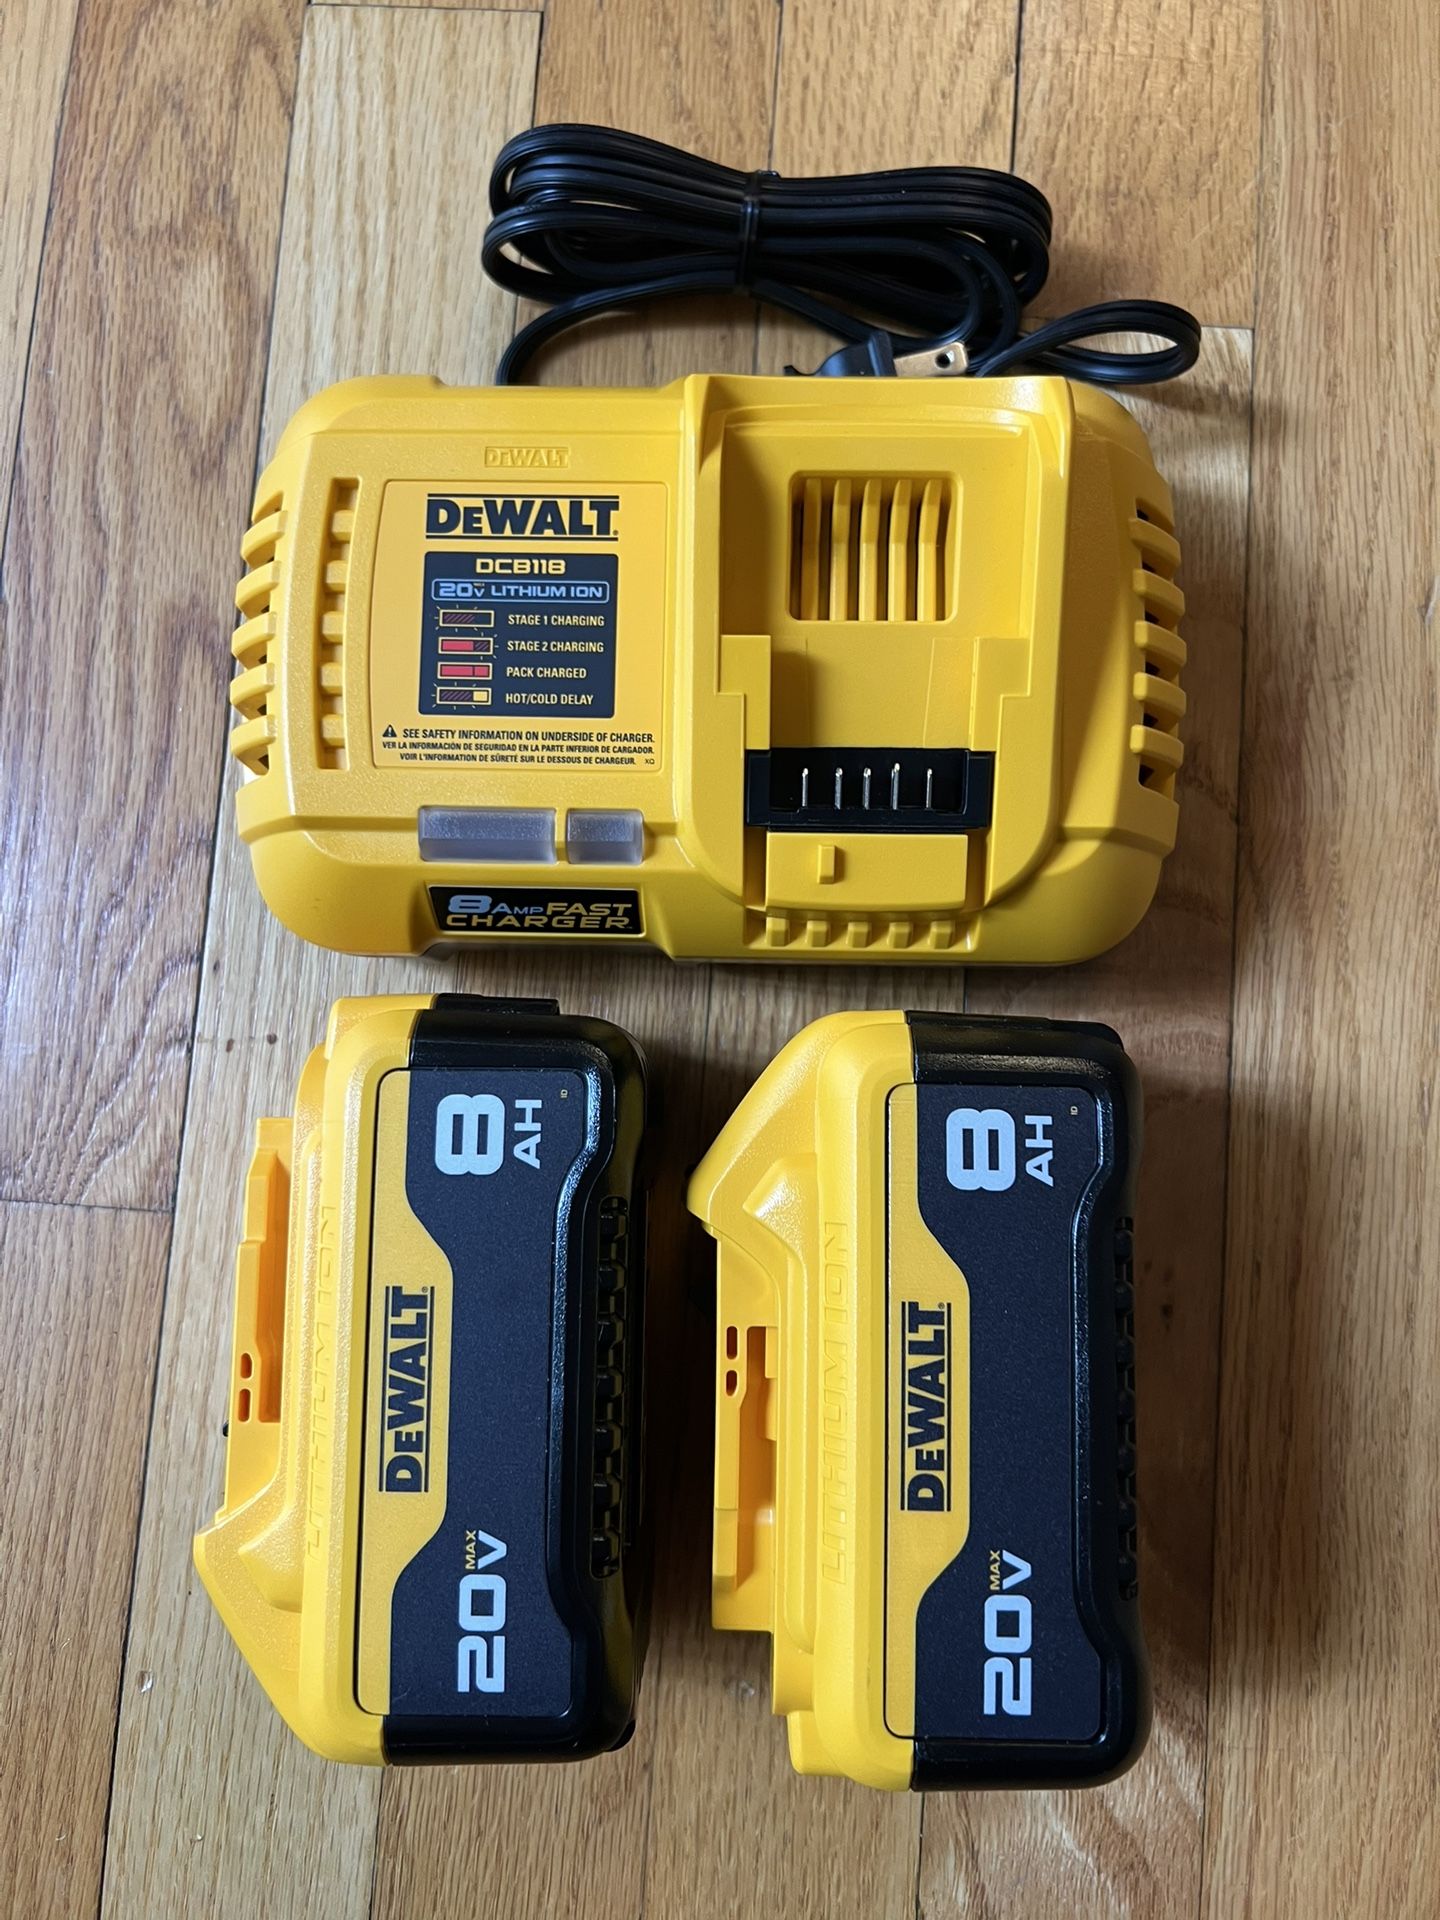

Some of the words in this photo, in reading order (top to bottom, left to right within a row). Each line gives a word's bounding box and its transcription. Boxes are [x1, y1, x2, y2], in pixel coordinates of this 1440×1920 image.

[486, 448, 569, 466] DEWALT
[426, 499, 619, 535] DEWALT
[475, 558, 566, 575] DCB118
[491, 585, 565, 598] LITHIUM
[570, 586, 603, 598] ION
[508, 615, 541, 626] STAGE
[543, 615, 548, 626] 1
[551, 615, 605, 627] CHARGING
[507, 640, 540, 652] STAGE
[542, 641, 548, 652] 2
[551, 641, 604, 653] CHARGING
[506, 667, 534, 678] PACK
[537, 667, 587, 679] CHARGED
[505, 693, 558, 705] HOT/COLD
[561, 694, 594, 705] DELAY
[382, 741, 396, 749] VER
[475, 743, 517, 752] SEGURIDAD
[519, 744, 528, 752] EN
[530, 744, 540, 752] LA
[566, 745, 599, 753] INFERIOR
[403, 728, 420, 739] SEE
[422, 729, 456, 740] SAFETY
[458, 730, 523, 740] INFORMATION
[525, 731, 539, 741] ON
[541, 731, 594, 742] UNDERSIDE
[596, 732, 608, 742] OF
[610, 733, 655, 743] CHARGER.
[400, 752, 417, 760] VOIR
[419, 753, 477, 762] L'INFORMATION
[479, 754, 488, 762] DE
[520, 755, 535, 763] SUR
[547, 756, 581, 764] DESSOUS
[448, 895, 492, 914] 8
[491, 903, 544, 915] AMP
[546, 903, 632, 917] FAST
[446, 914, 630, 929] CHARGER
[435, 1094, 505, 1175] 8
[513, 1099, 542, 1169] AH
[946, 1108, 1016, 1191] 8
[1025, 1115, 1054, 1187] AH
[824, 1221, 848, 1324] ION
[306, 1322, 329, 1560] LITHIUM
[318, 1206, 336, 1304] ION
[385, 1286, 428, 1493] DEWALT
[907, 1301, 945, 1512] DEWALT
[822, 1339, 848, 1585] LITHIUM
[465, 1530, 476, 1570] MAX
[990, 1550, 1000, 1590] MAX
[457, 1530, 507, 1692] 20V
[983, 1550, 1032, 1716] 20V
